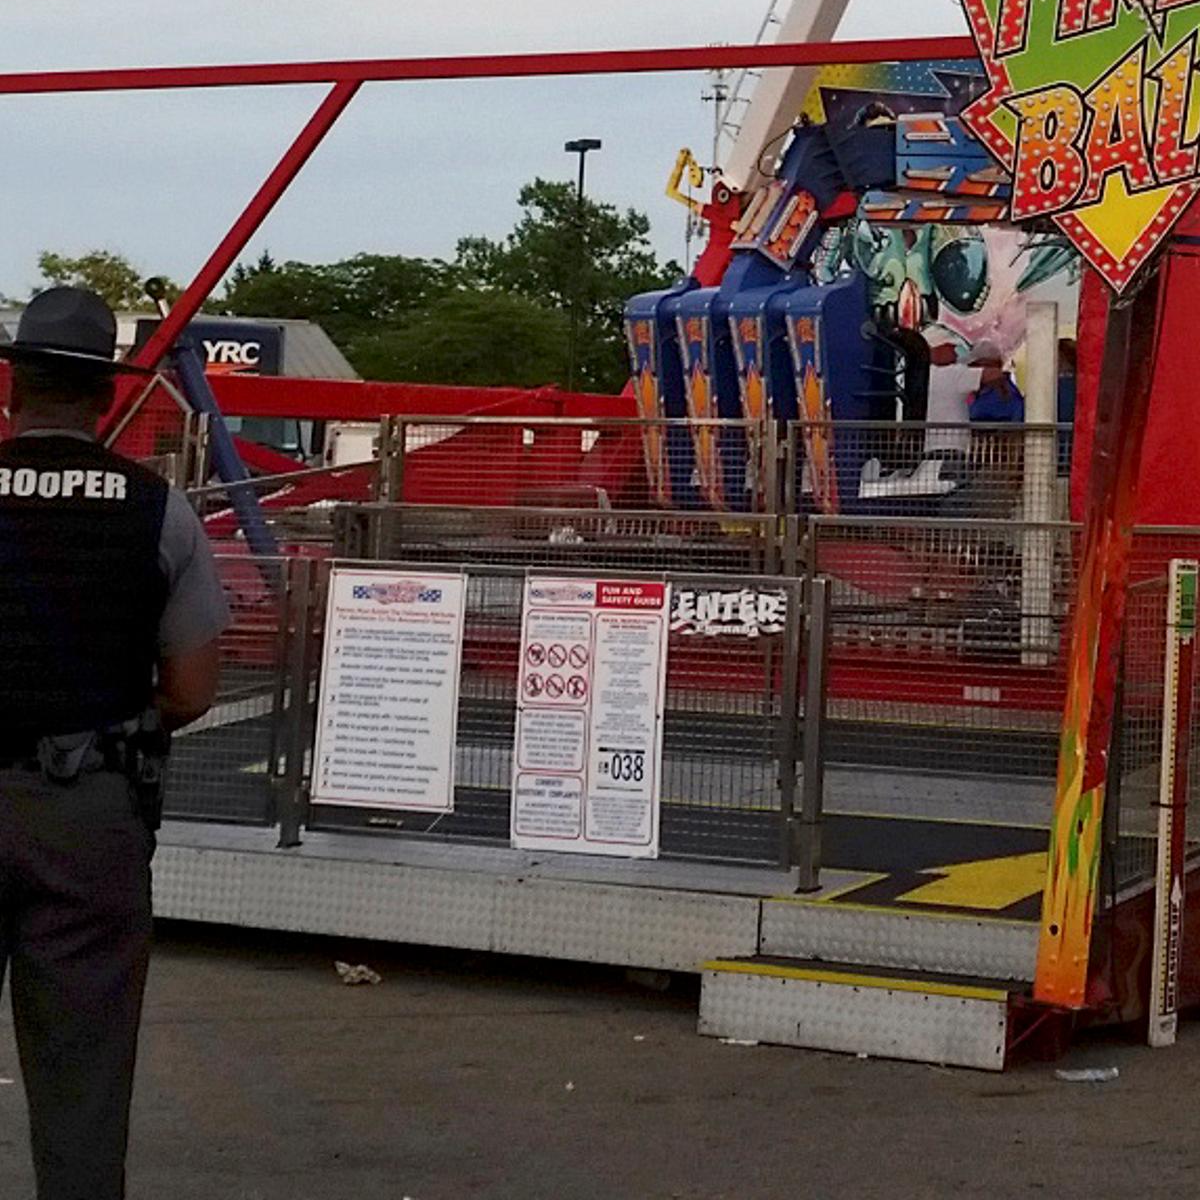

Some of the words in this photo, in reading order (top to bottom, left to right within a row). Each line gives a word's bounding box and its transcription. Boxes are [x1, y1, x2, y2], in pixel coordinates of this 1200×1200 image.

[203, 341, 260, 364] YRC
[602, 586, 620, 595] FUN
[622, 587, 643, 596] AND
[602, 595, 632, 605] SAFETY
[633, 597, 661, 606] GUIDE
[678, 591, 780, 623] ENTER
[611, 754, 643, 781] 038
